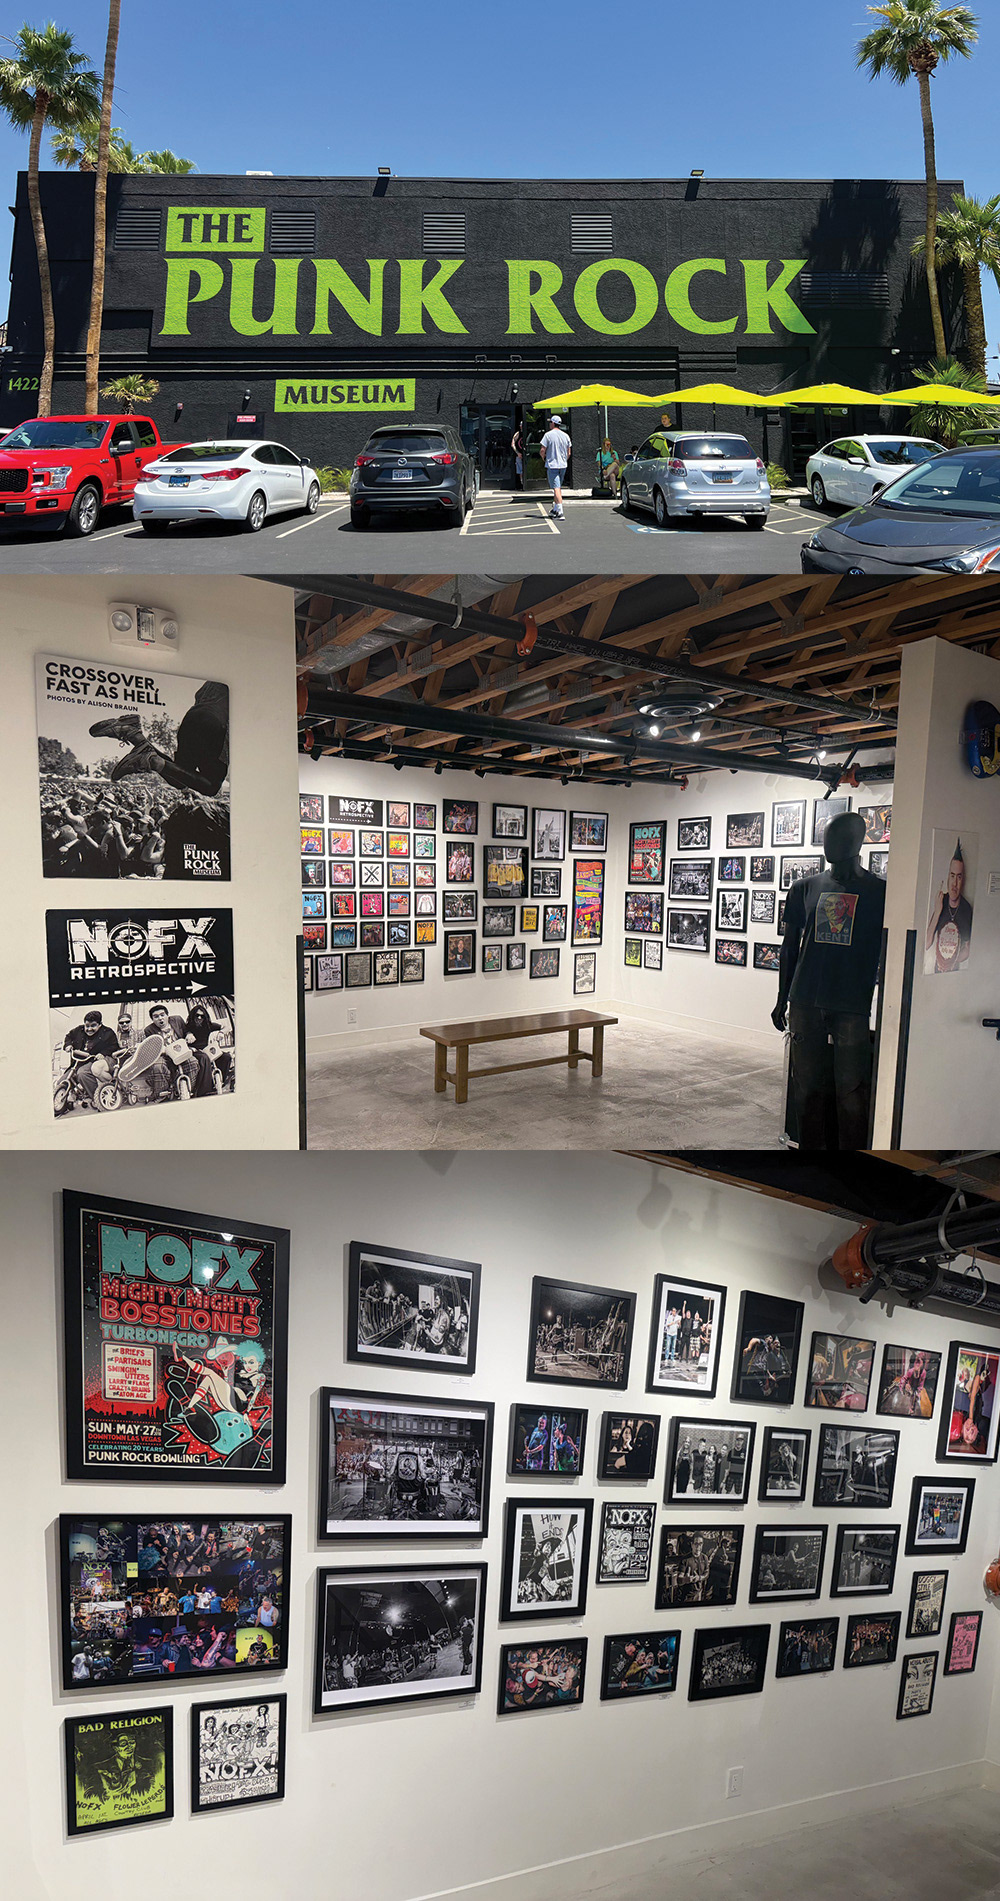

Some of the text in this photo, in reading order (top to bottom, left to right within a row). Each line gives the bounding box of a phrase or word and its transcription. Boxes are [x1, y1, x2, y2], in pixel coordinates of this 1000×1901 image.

[176, 213, 254, 243] THE
[158, 258, 818, 336] PUNK ROCK
[8, 377, 39, 391] 1422
[283, 384, 407, 405] MUSEUM
[45, 661, 160, 694] CROSSOVER,
[46, 677, 166, 706] FAST AS HELL.
[47, 694, 76, 704] PHOTOS
[87, 700, 113, 709] ALISON
[114, 703, 139, 712] BRAUN
[339, 799, 374, 813] NOFX
[635, 827, 661, 839] NOFX
[184, 850, 220, 860] PUNK
[184, 860, 221, 870] ROCK
[67, 916, 217, 965] NOFX
[817, 931, 849, 943] KENT
[376, 952, 397, 960] EXCEL
[70, 961, 216, 980] RETROSPECTIVE
[101, 1224, 262, 1291] NOFX
[101, 1277, 261, 1315] MIGHTY MIGHTY
[101, 1297, 260, 1336] BOSSTONES
[101, 1323, 210, 1349] TURBONEGRO
[120, 1348, 145, 1357] BRIEFS
[114, 1357, 152, 1367] PARTISANS
[88, 1422, 112, 1434] SUN
[116, 1423, 140, 1435] MAY
[88, 1433, 162, 1443] DOWNTOWN LAS VEGAS
[88, 1451, 200, 1464] PUNK ROCK BOWLING
[610, 1509, 649, 1525] NOFX
[541, 1527, 564, 1540] ENDS
[82, 1562, 111, 1571] NOFX
[78, 1715, 162, 1734] BAD RELIGION
[76, 1801, 102, 1811] NOFX
[113, 1803, 140, 1811] FLOWER
